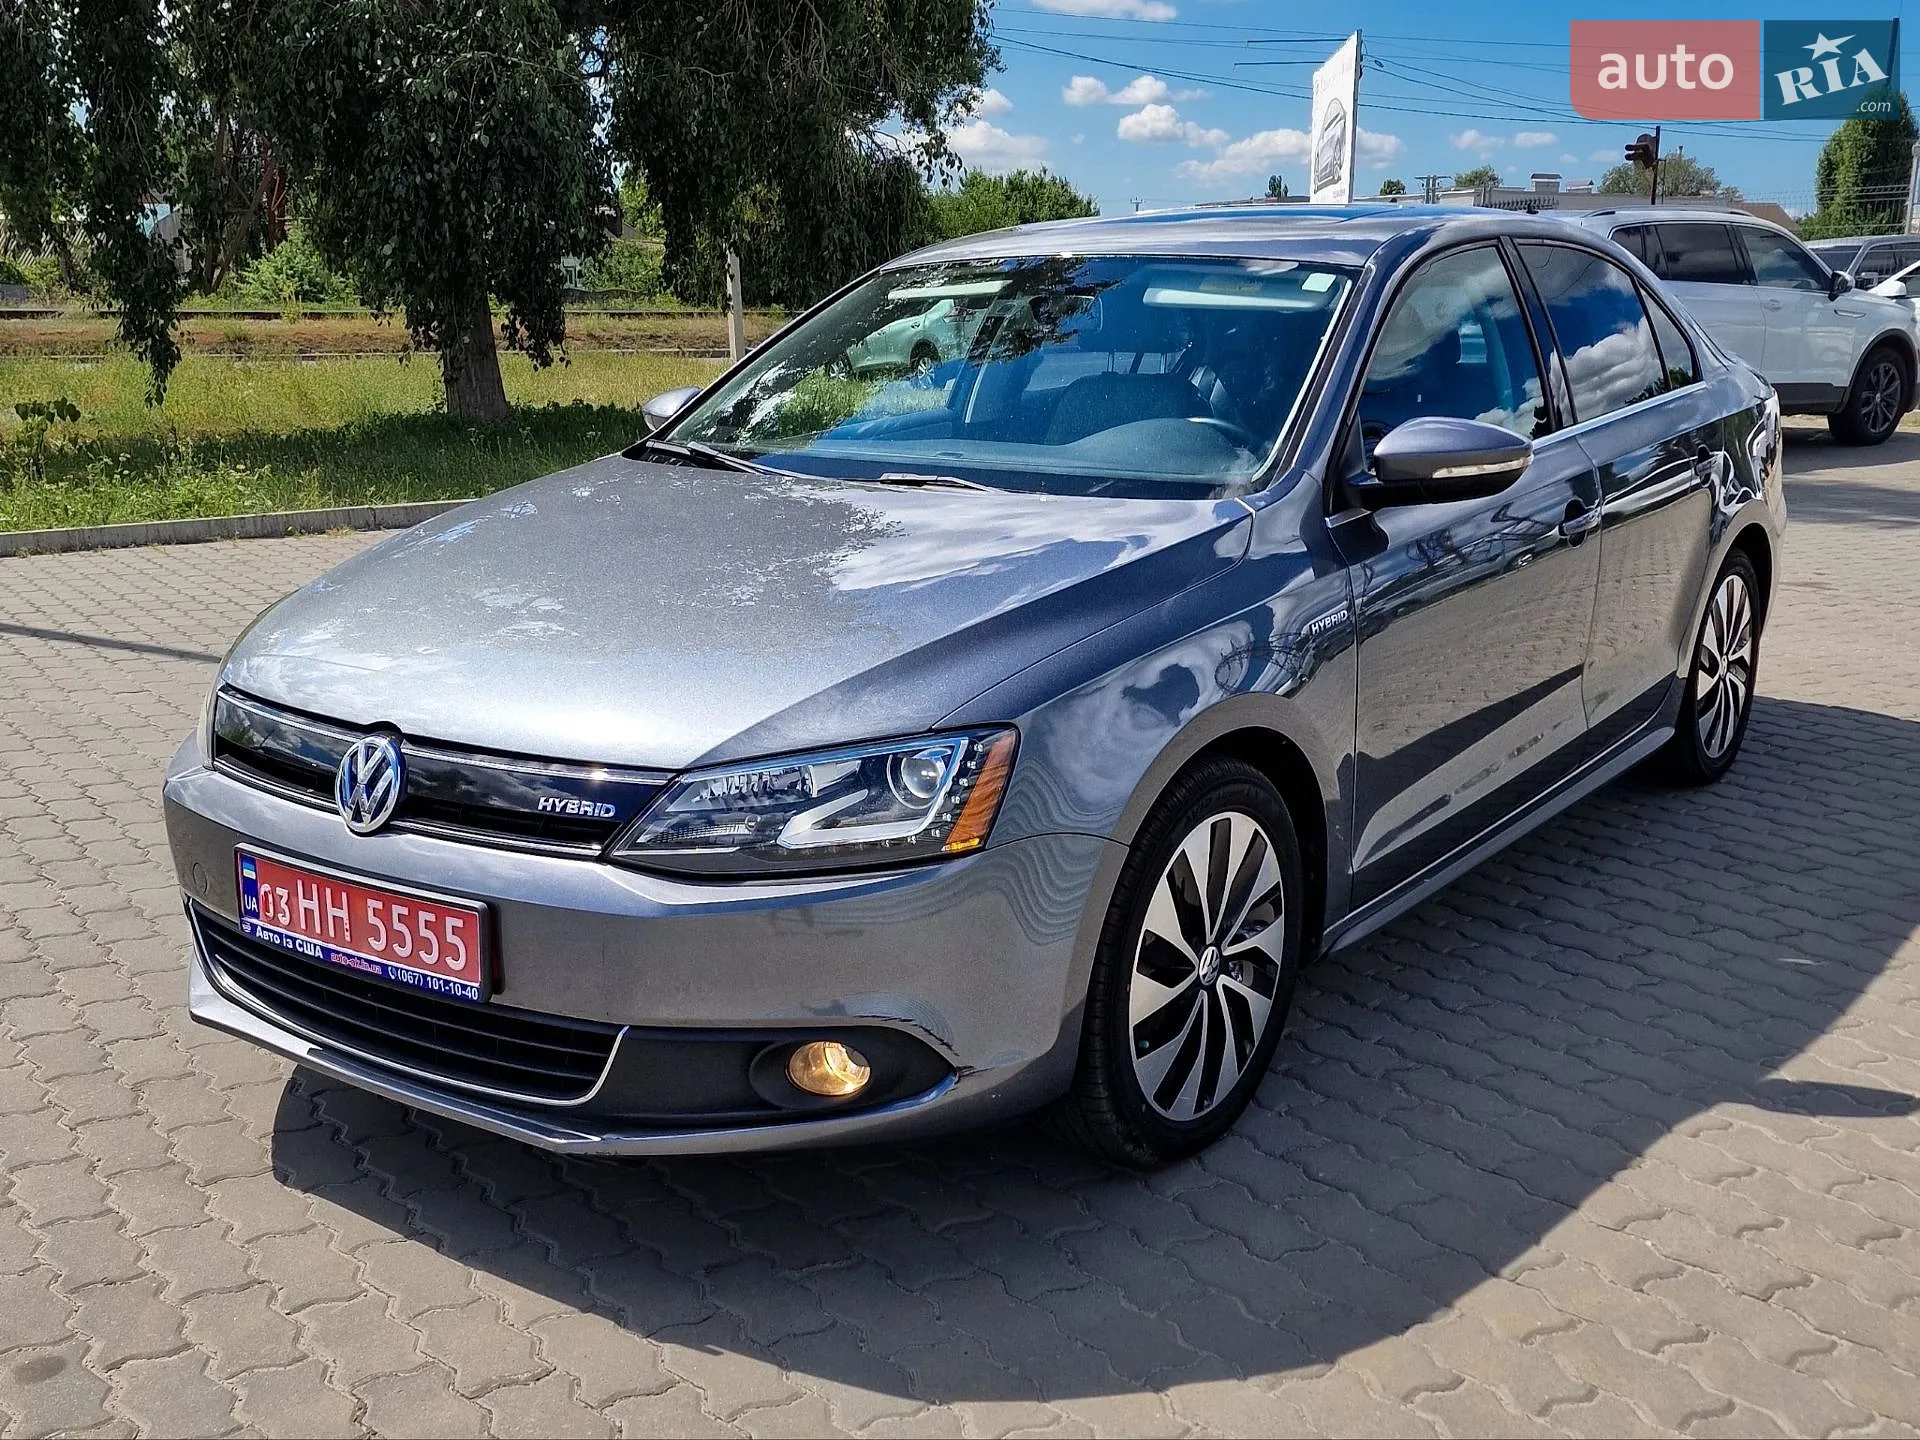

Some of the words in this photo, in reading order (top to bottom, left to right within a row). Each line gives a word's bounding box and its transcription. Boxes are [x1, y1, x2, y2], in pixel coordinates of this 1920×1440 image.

[1311, 609, 1348, 635] HYBRID
[537, 796, 616, 818] HYBRID
[244, 893, 258, 912] UA
[256, 926, 280, 944] Авто
[296, 940, 323, 959] США
[366, 898, 467, 971] 5555
[398, 970, 423, 987] (067)
[427, 976, 479, 1000] 101-10-40
